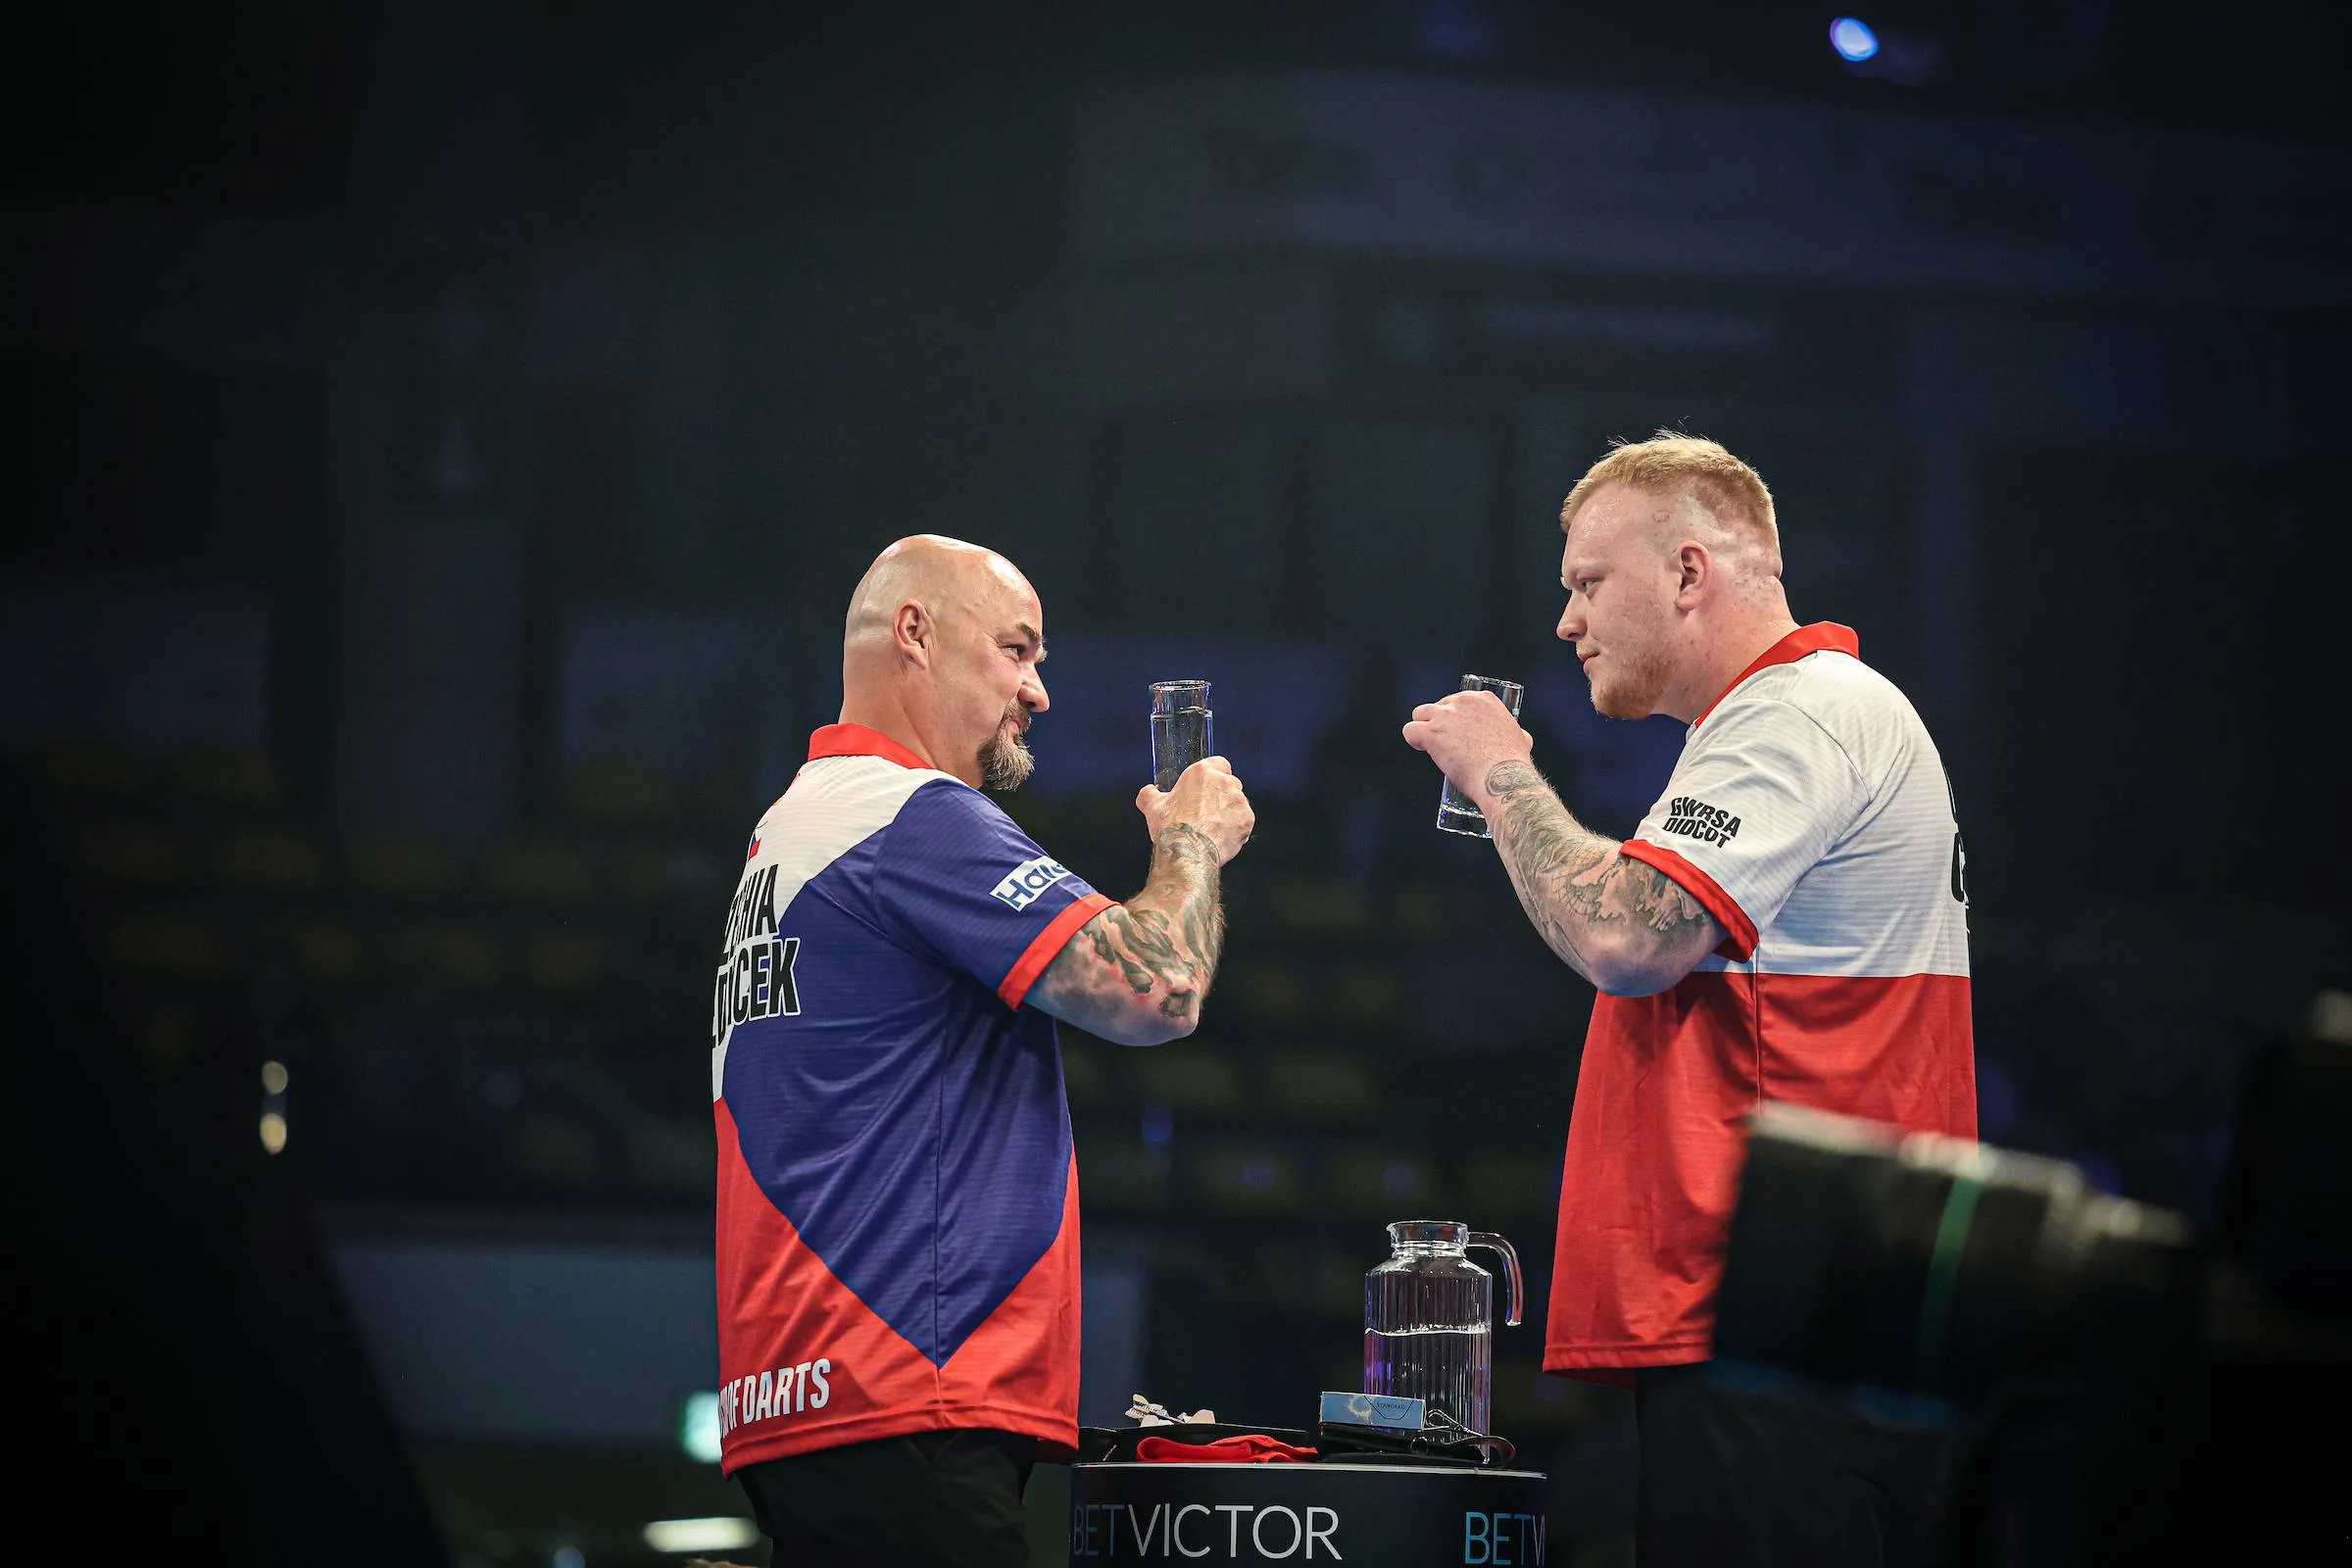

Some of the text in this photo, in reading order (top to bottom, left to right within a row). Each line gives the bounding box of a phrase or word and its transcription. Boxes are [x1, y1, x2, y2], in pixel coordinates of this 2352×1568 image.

[1662, 817, 1731, 849] DIDCOT
[1670, 797, 1741, 838] GWRSA
[742, 1358, 831, 1425] DARTS
[1073, 1502, 1343, 1560] BETVICTOR
